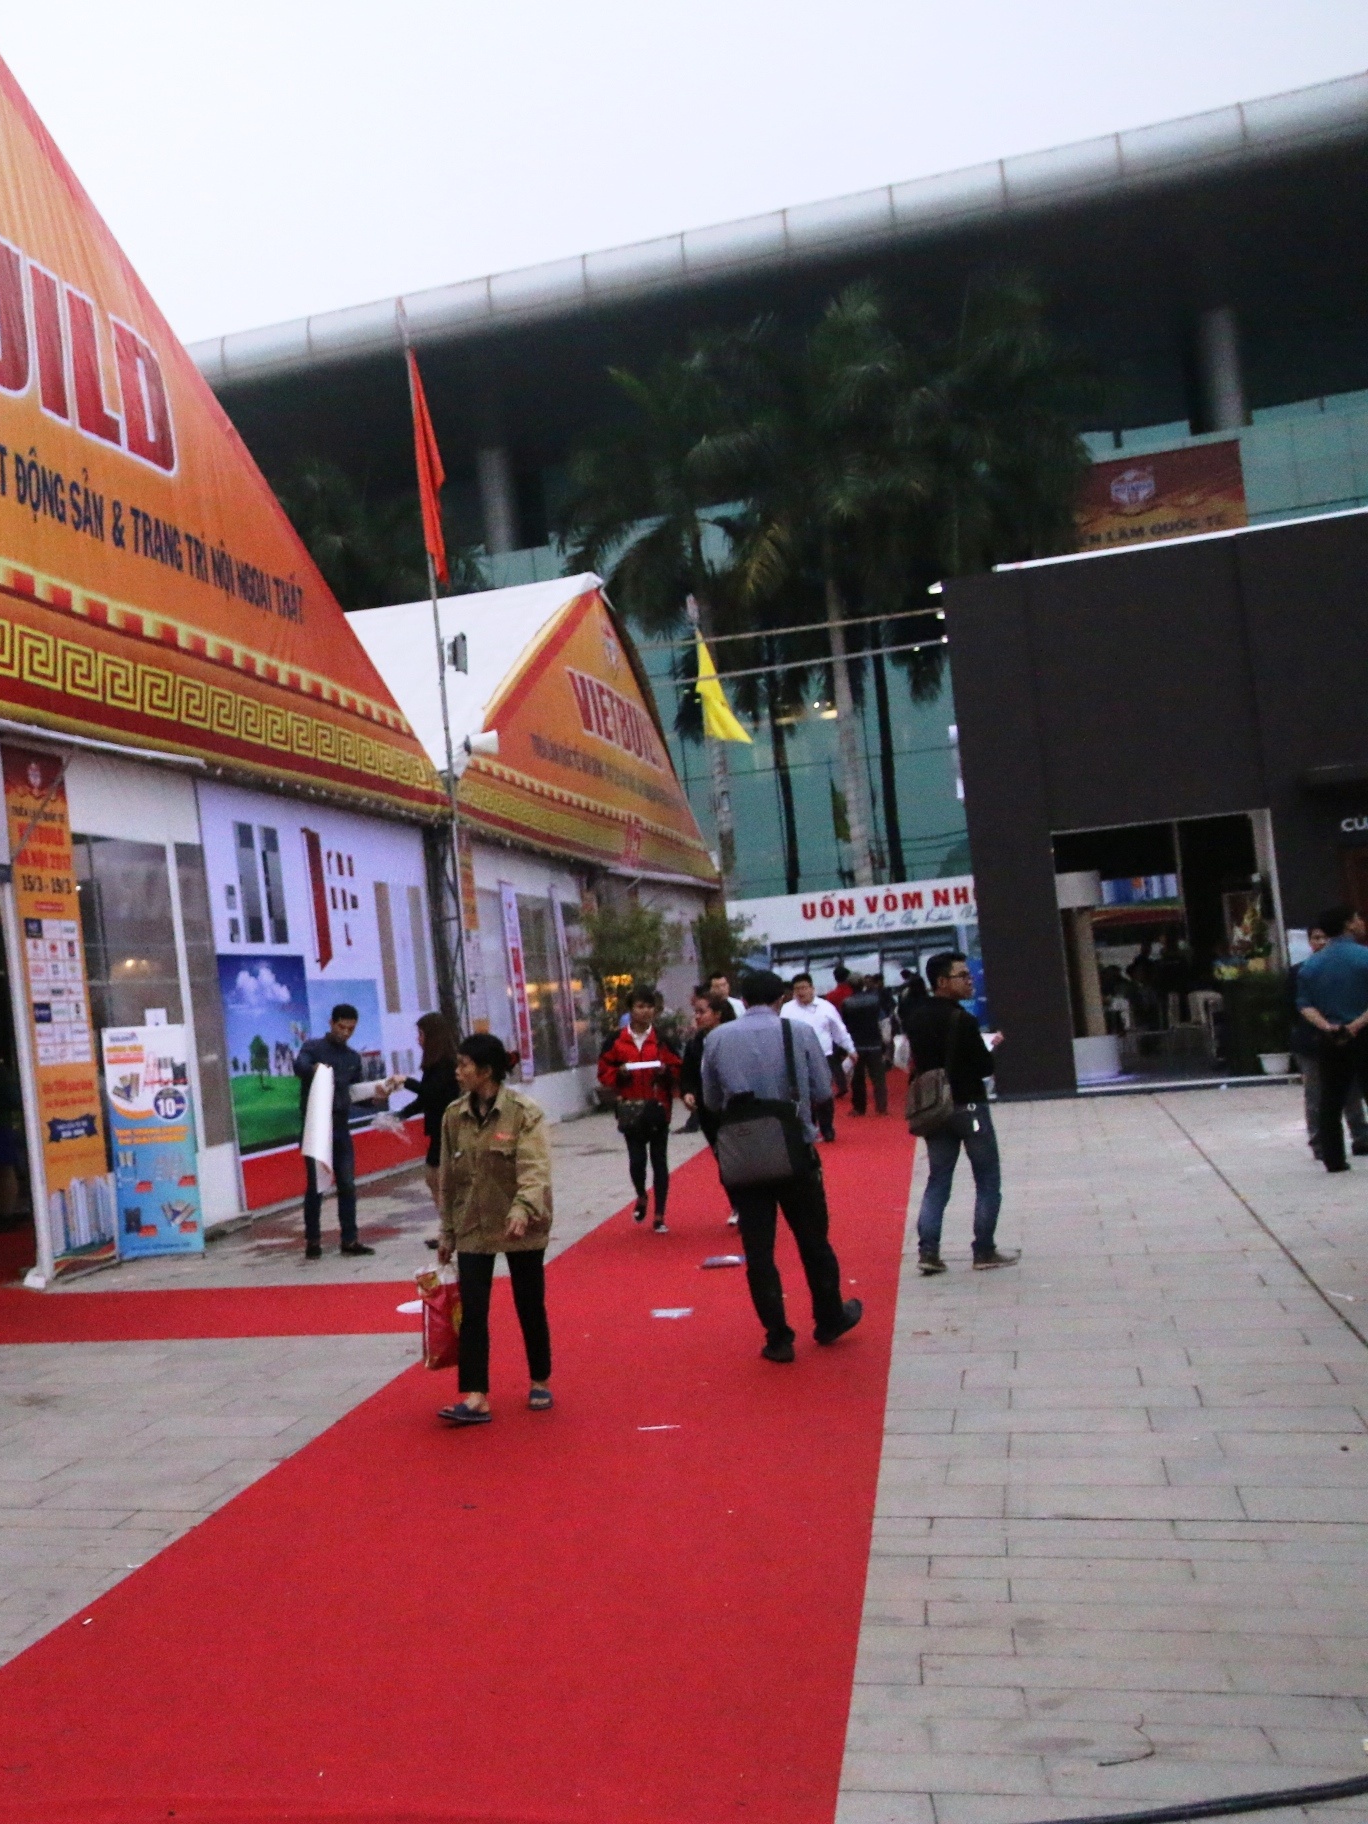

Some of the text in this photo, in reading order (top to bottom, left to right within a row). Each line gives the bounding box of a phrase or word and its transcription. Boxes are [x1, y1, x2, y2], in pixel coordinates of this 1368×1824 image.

[14, 447, 66, 523] ĐỘNG
[70, 467, 105, 542] SẢN
[112, 500, 125, 550] &
[130, 506, 183, 573] TRANG
[185, 531, 209, 585] TRÍ
[801, 892, 856, 920] UỐN
[933, 886, 973, 907] NH
[157, 1098, 176, 1117] 10
